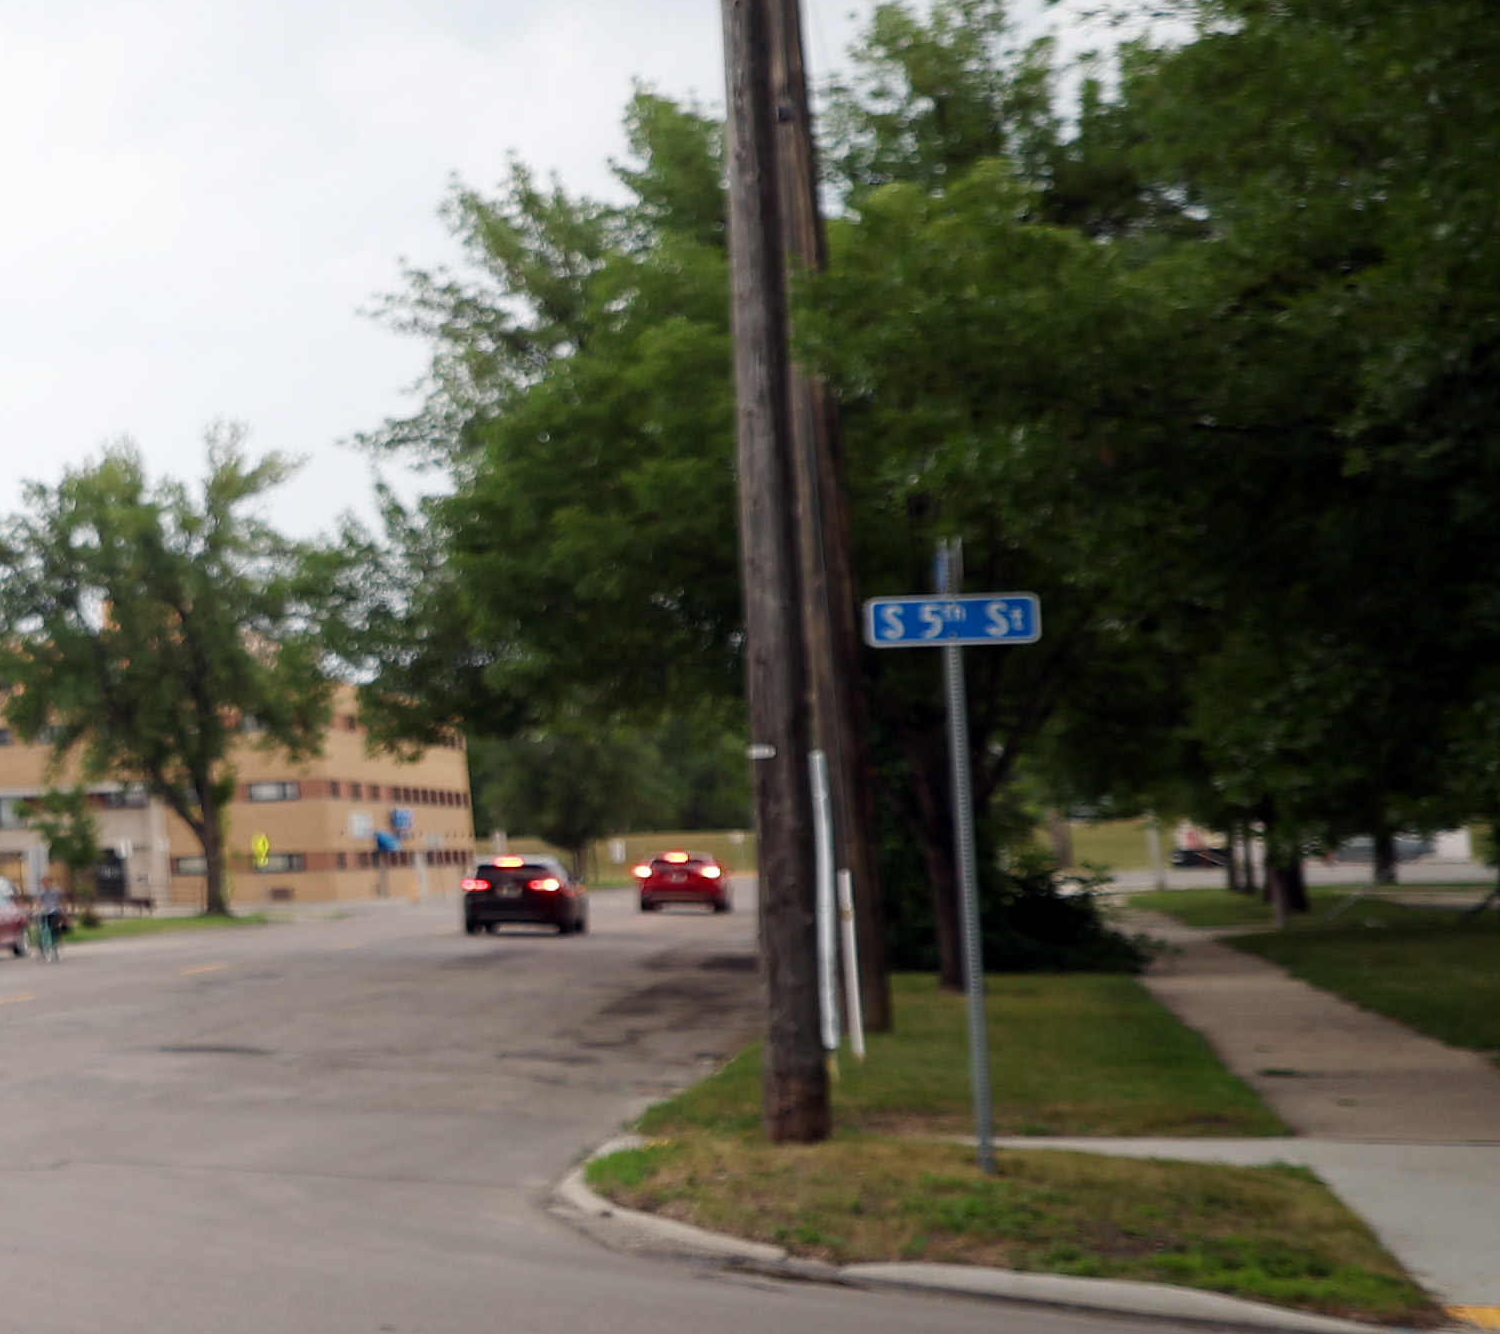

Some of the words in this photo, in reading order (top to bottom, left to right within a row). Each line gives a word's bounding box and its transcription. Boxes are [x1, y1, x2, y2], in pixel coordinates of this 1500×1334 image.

[880, 604, 906, 640] S
[918, 602, 967, 639] 5th
[984, 600, 1025, 637] St
